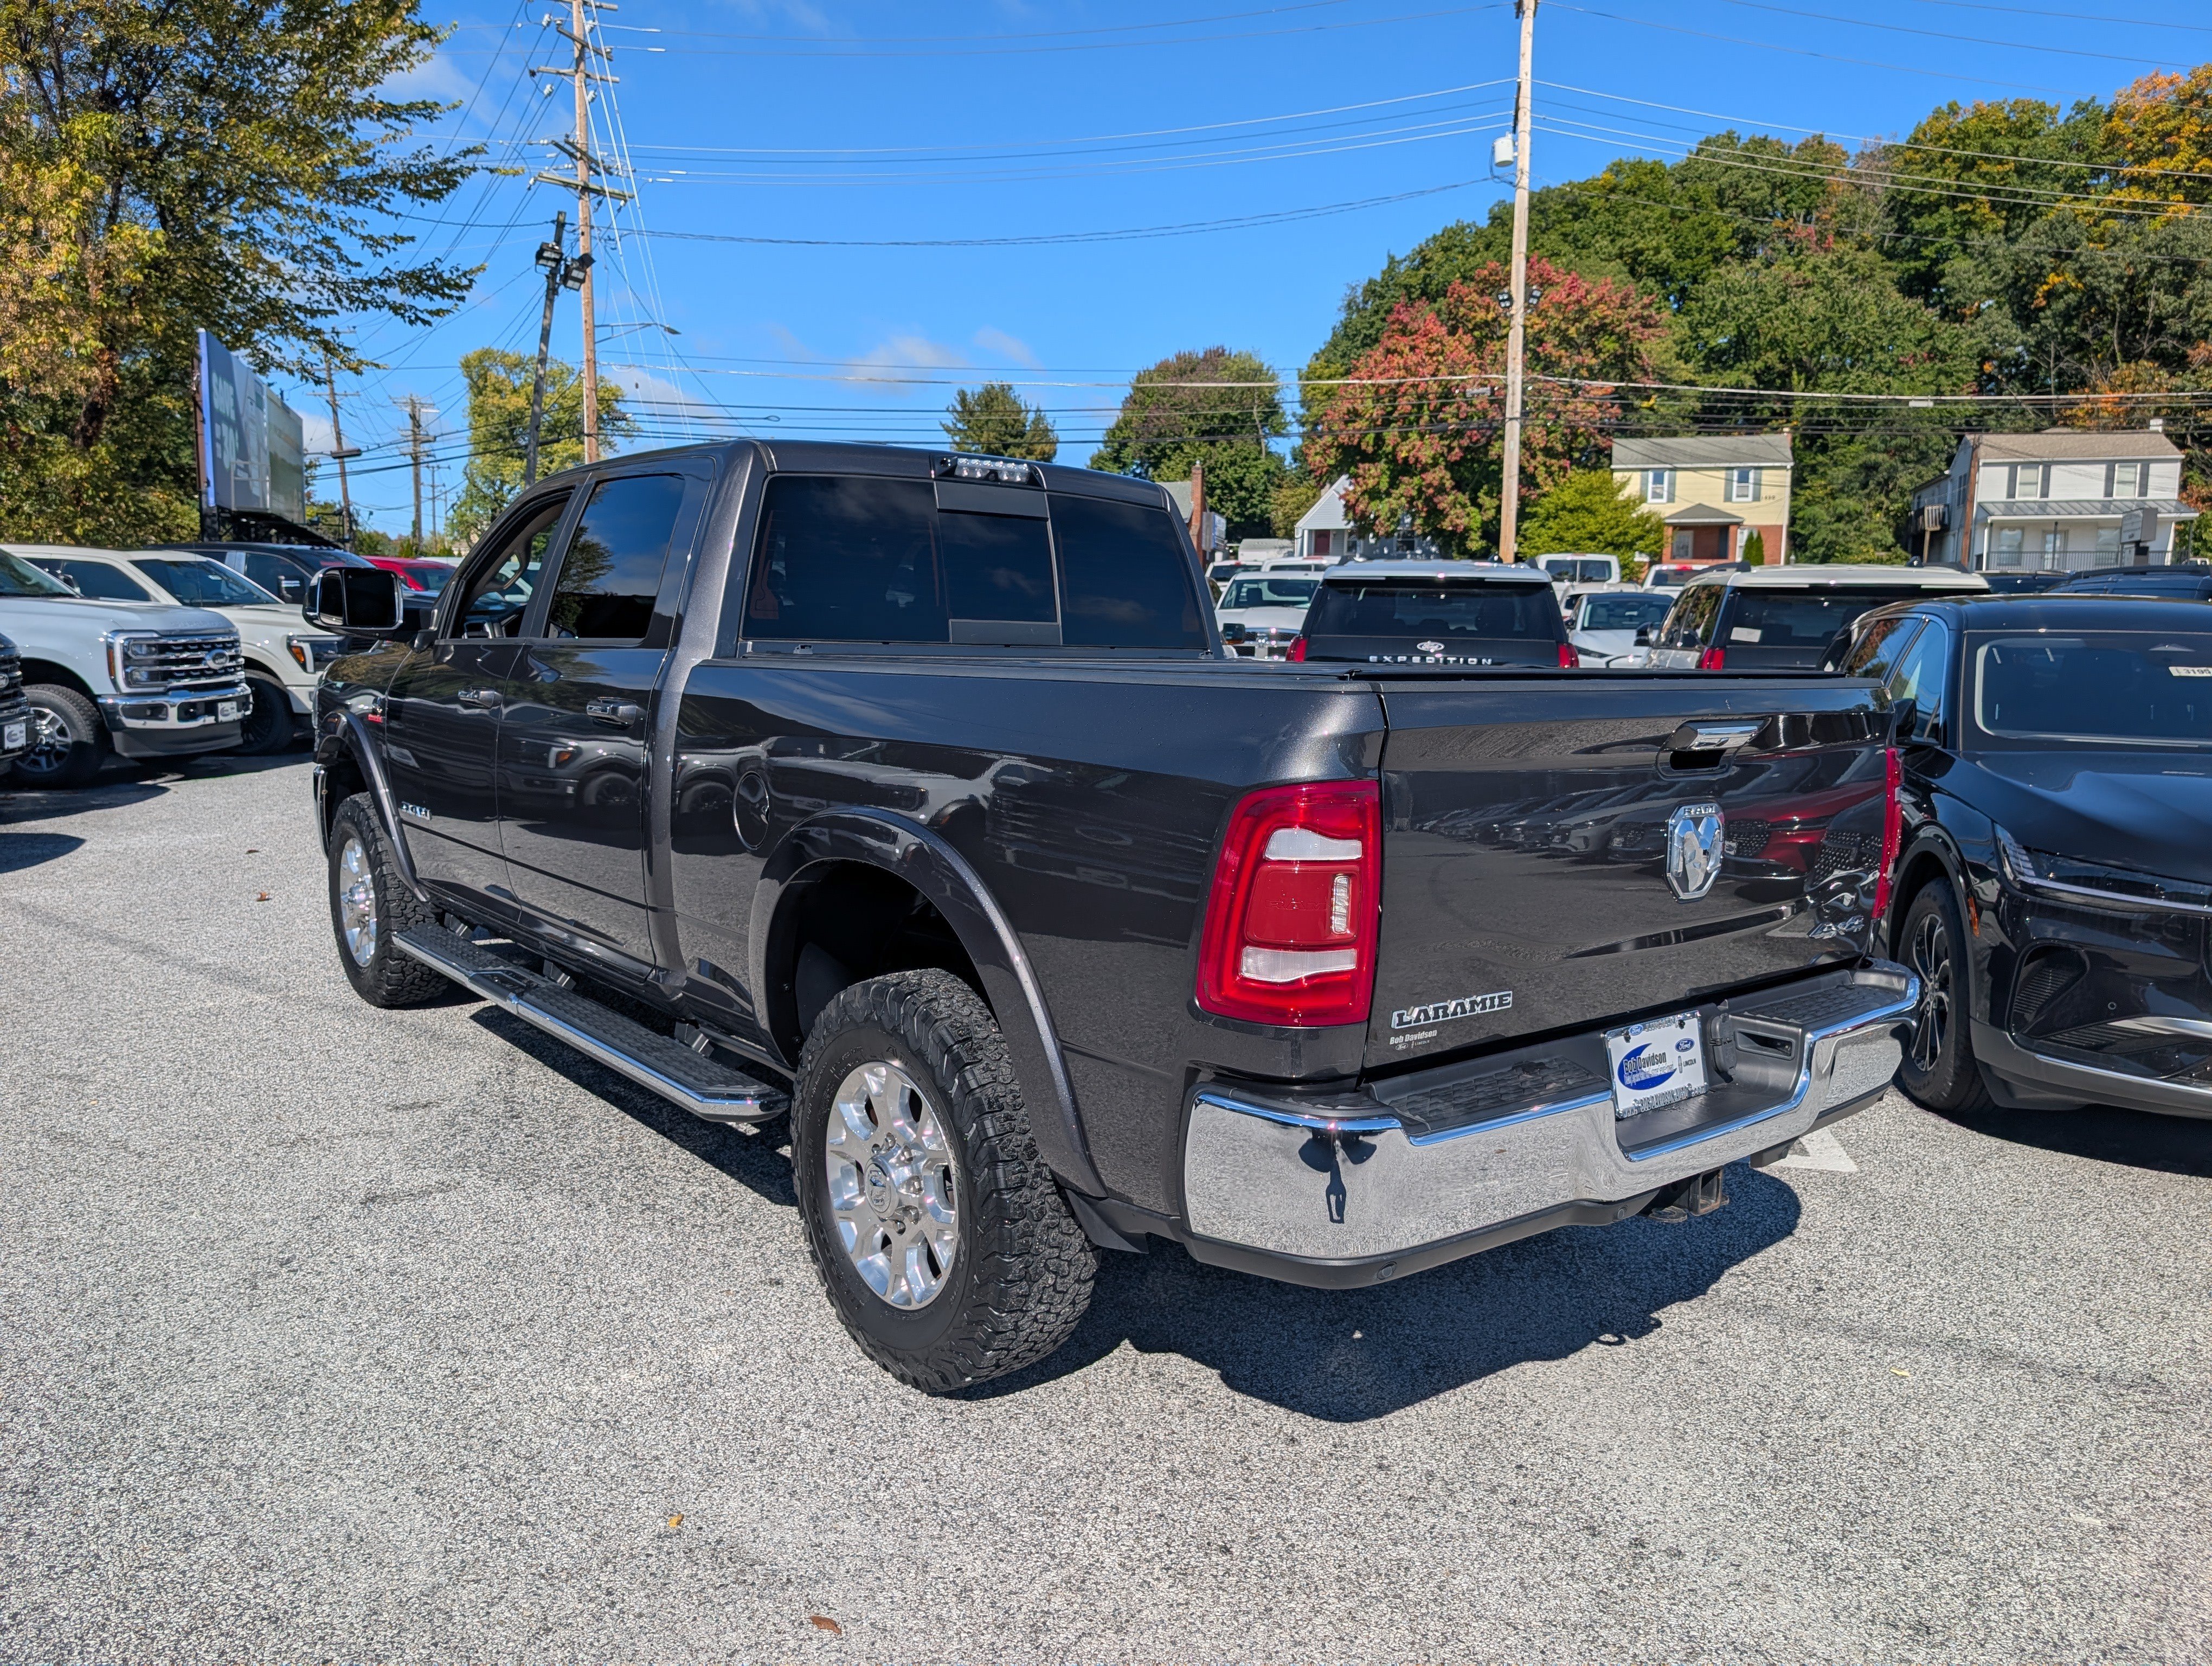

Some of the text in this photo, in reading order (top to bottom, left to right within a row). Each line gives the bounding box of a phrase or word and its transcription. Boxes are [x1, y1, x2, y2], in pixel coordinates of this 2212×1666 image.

[1369, 655, 1493, 665] EXPEDITION
[1683, 805, 1715, 816] RAM
[1265, 899, 1327, 911] RAM
[1391, 991, 1513, 1029] LARAMIE
[1389, 1029, 1437, 1045] Bob Davidson
[1677, 1039, 1693, 1051] Ford
[1623, 1052, 1667, 1073] Bob Davidson
[1682, 1058, 1696, 1067] LINCOLN
